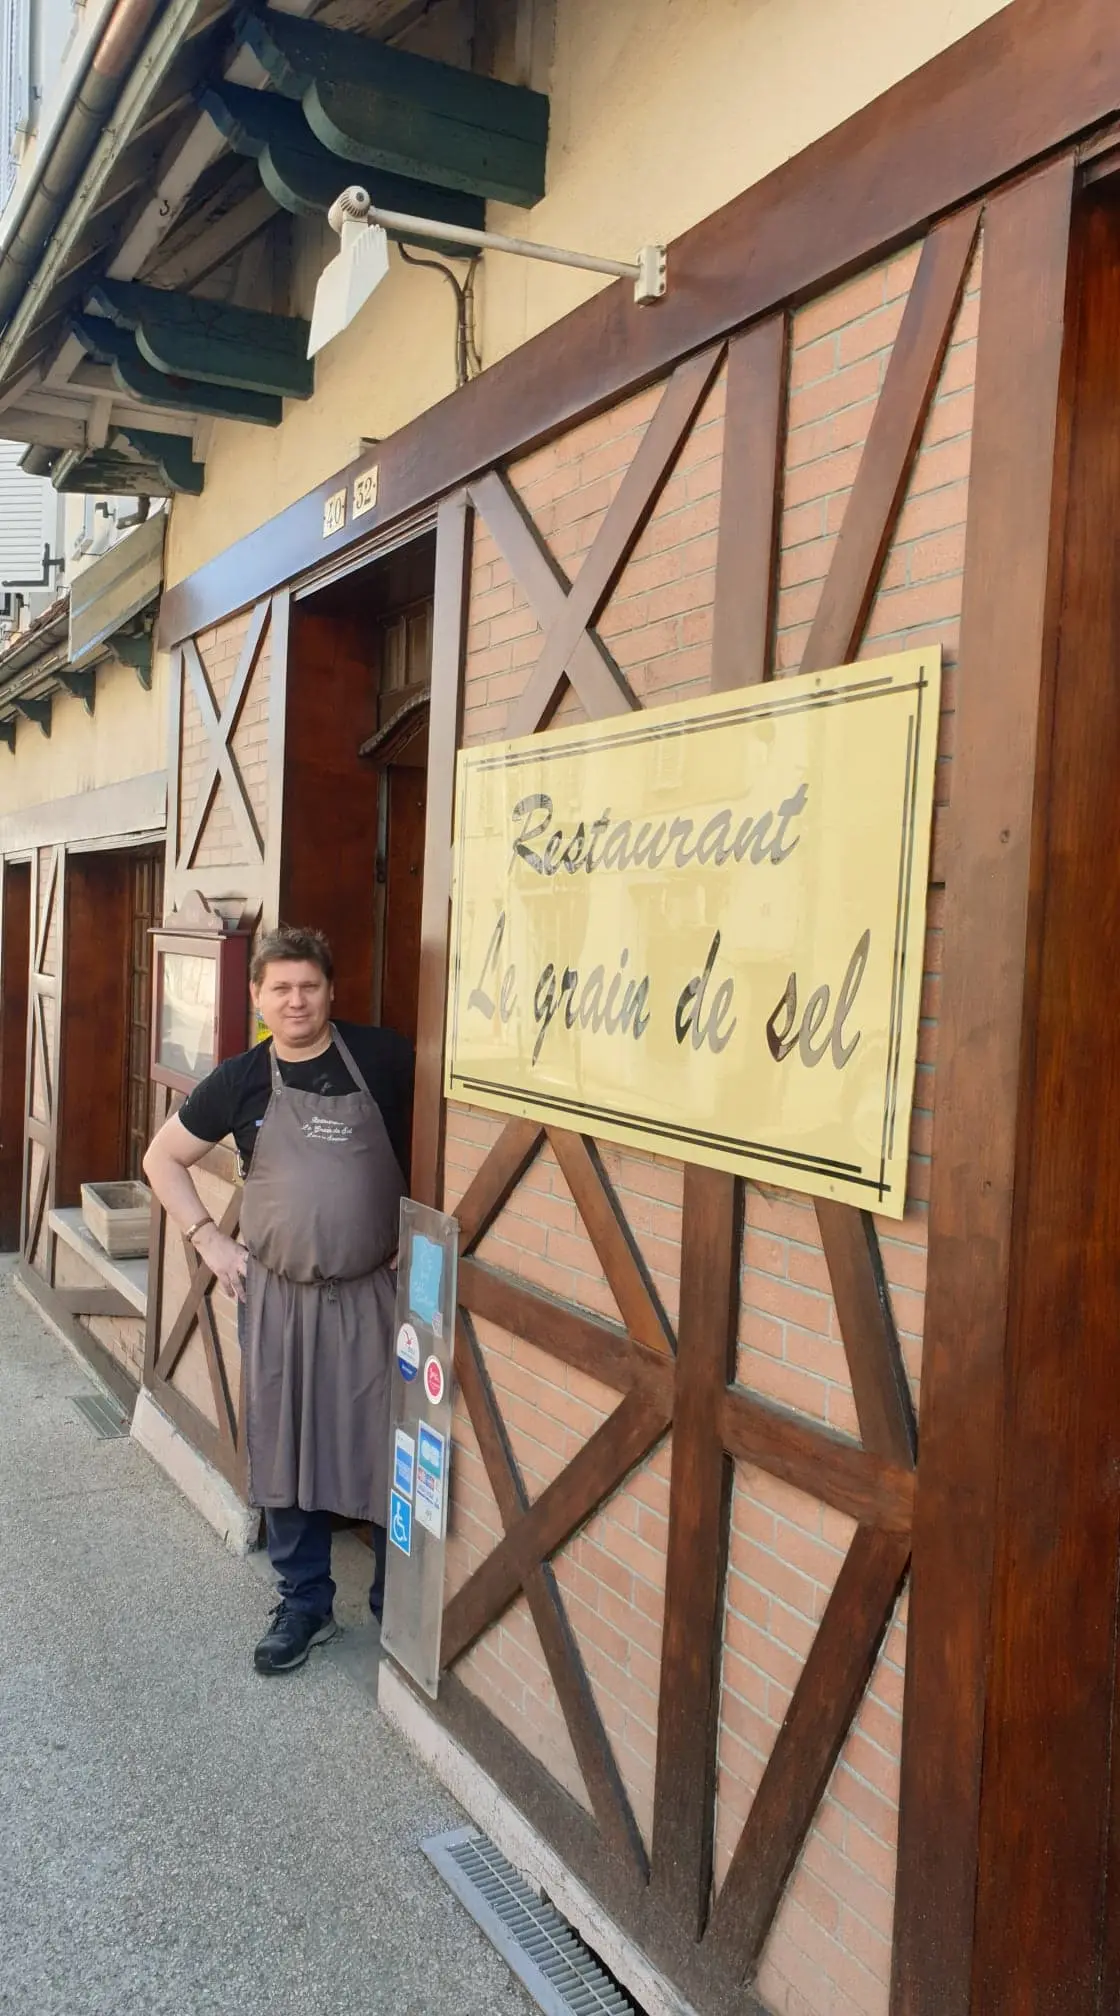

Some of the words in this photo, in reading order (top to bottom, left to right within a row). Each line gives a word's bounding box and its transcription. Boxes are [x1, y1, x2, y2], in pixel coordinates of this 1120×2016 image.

[327, 498, 342, 528] 40
[357, 477, 372, 509] 32
[509, 782, 809, 876] Restaurant
[468, 911, 518, 1023] Le
[532, 948, 651, 1066] grain
[675, 929, 738, 1054] de
[766, 928, 872, 1070] sel
